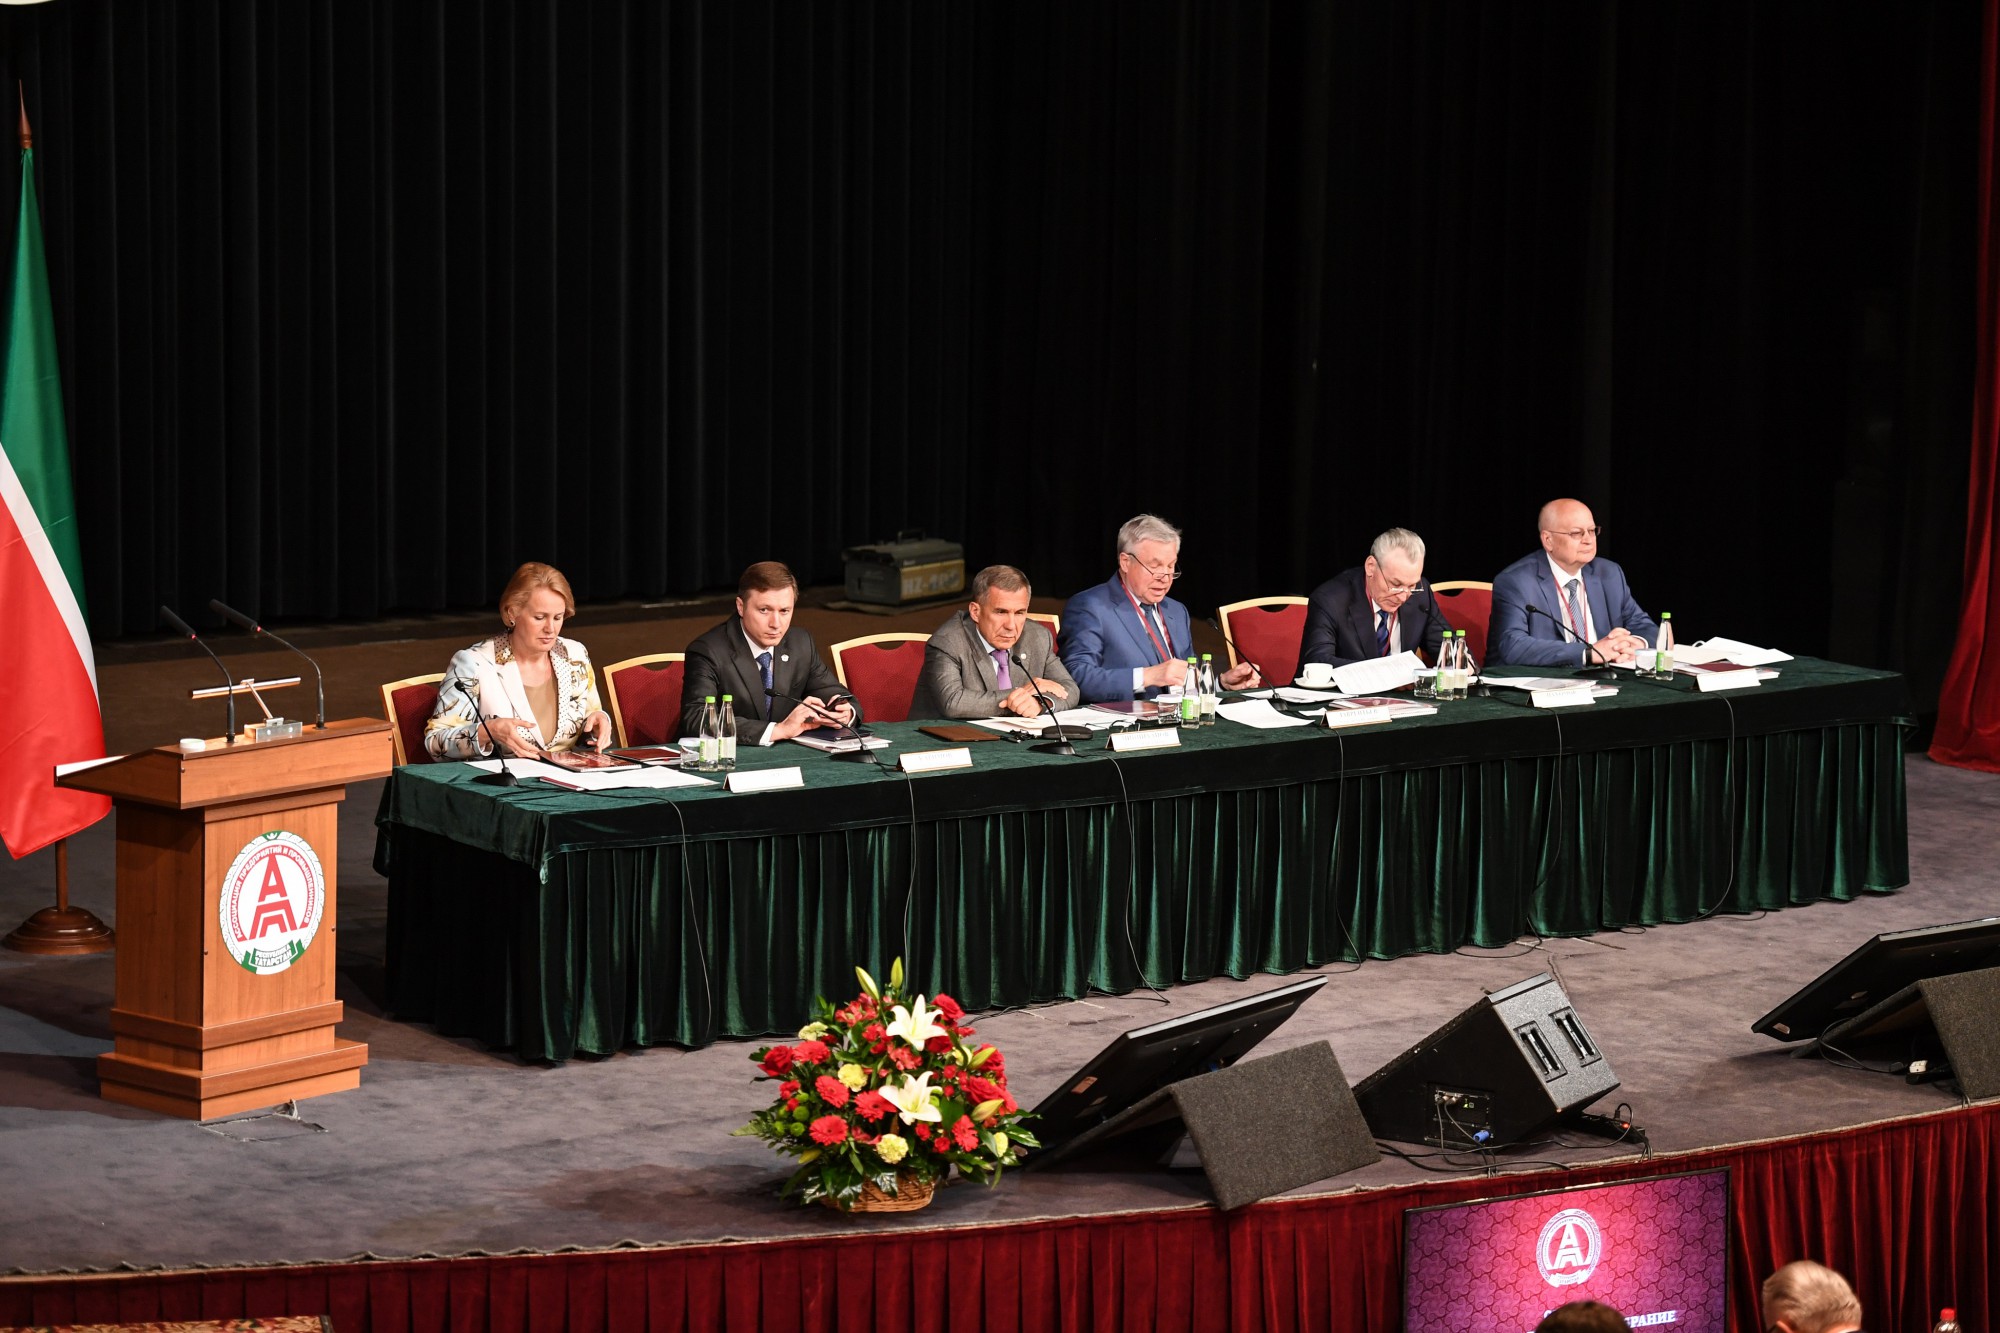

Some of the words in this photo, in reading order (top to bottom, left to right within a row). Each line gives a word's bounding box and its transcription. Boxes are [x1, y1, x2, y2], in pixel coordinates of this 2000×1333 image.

[231, 880, 243, 939] АССОЦИАЦИЯ
[239, 845, 282, 881] ПРЕДПРИЯТИЙ
[282, 846, 289, 855] И
[288, 849, 314, 924] ПРОМЫШЛЕННИКОВ
[254, 951, 292, 967] ТАТАРСТАН
